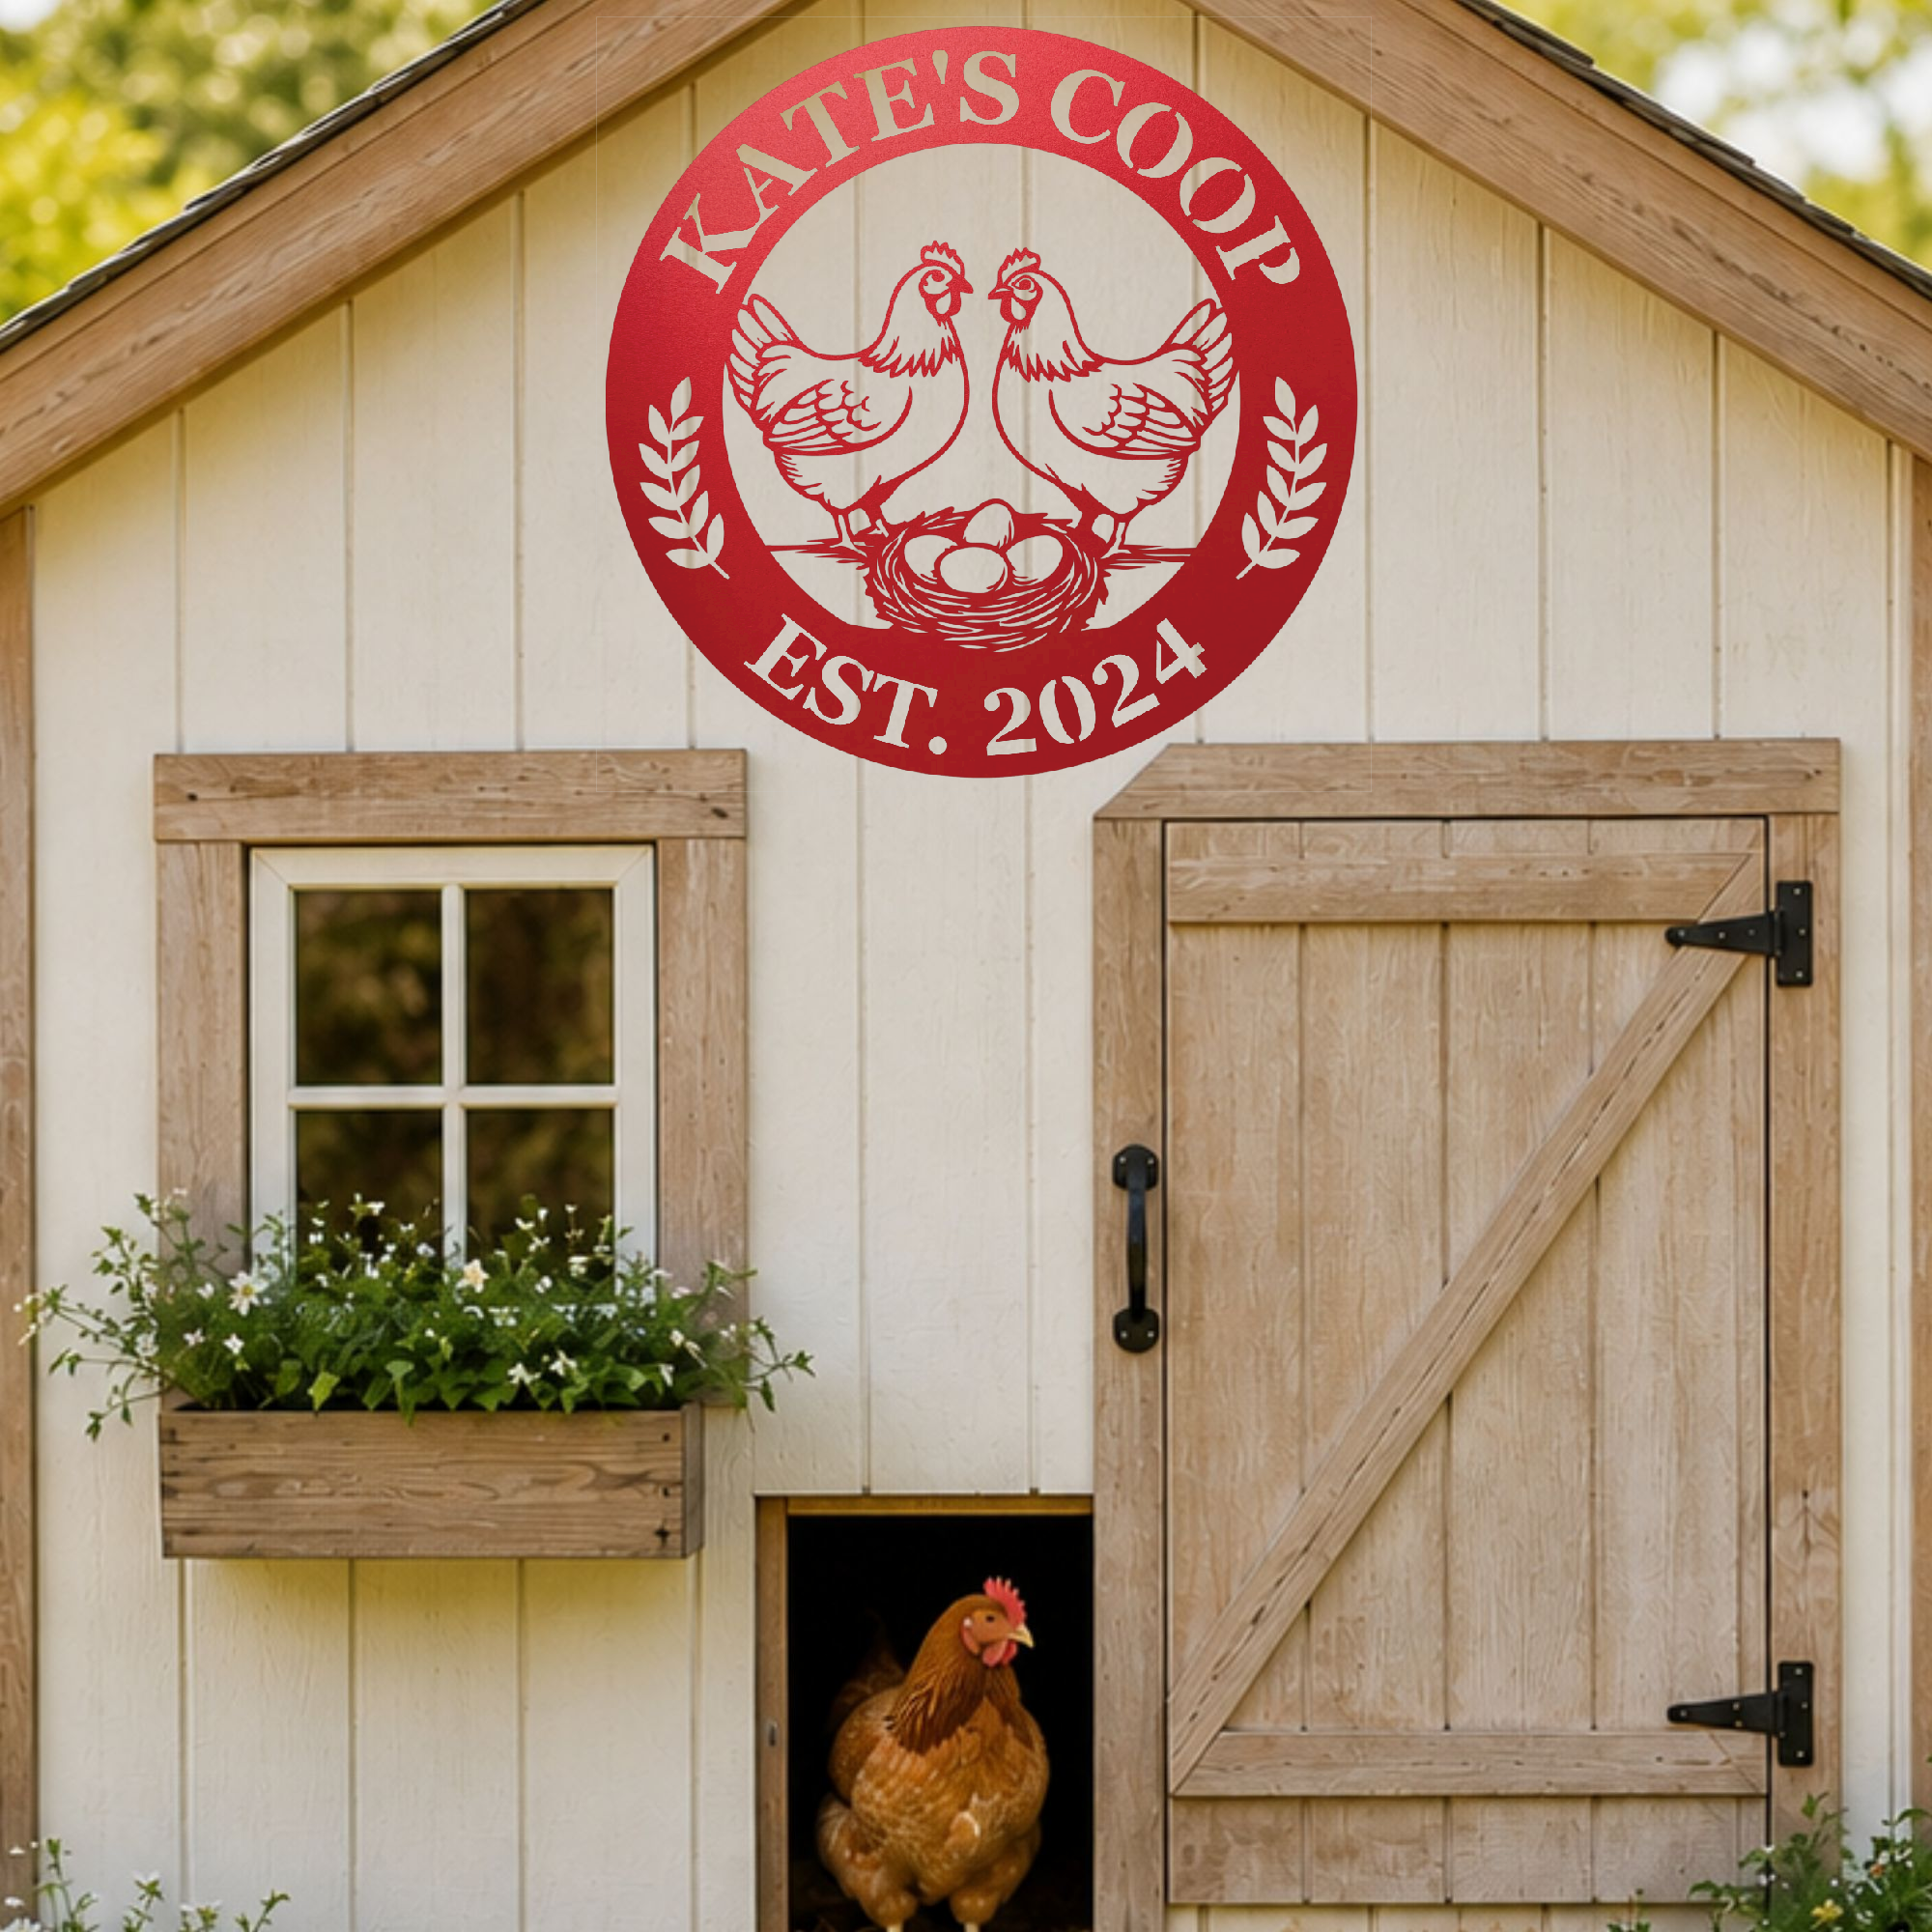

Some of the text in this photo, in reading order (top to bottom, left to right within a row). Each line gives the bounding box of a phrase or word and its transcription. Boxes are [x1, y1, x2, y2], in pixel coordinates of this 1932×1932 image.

[659, 49, 1301, 295] KATE'S COOP
[743, 613, 1208, 756] EST. 2024
